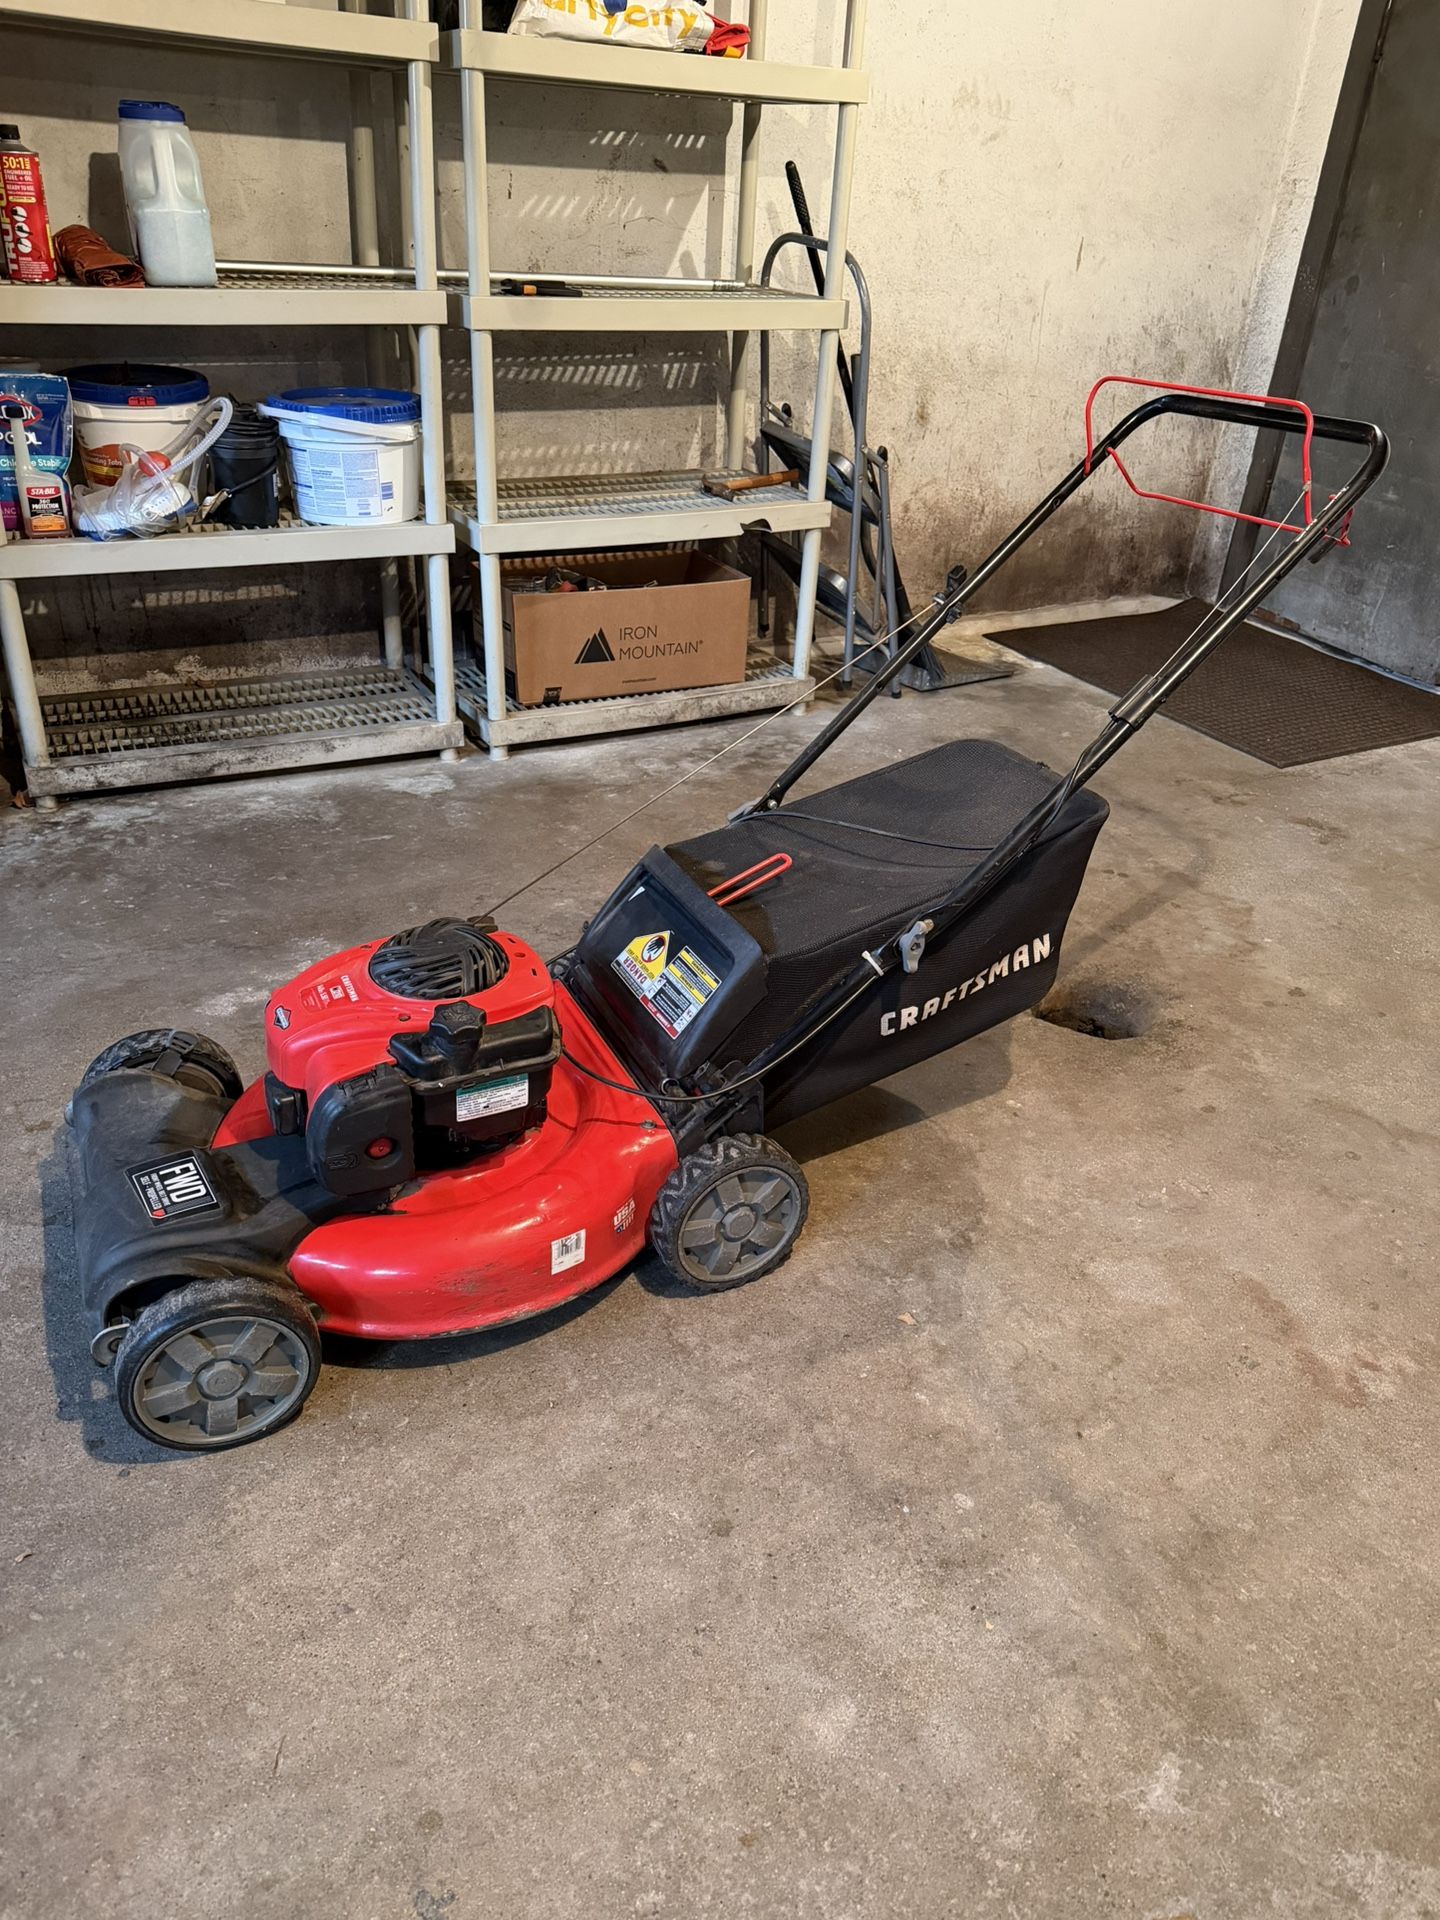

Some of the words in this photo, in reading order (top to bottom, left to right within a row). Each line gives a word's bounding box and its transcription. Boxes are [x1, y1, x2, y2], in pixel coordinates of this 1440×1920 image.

[2, 156, 25, 169] 50:1
[619, 625, 658, 641] IRON
[623, 956, 648, 985] DANGER
[340, 974, 360, 1002] CRAFTSMAN
[880, 933, 1051, 1037] CRAFTSMAN
[159, 1162, 207, 1203] FWD
[613, 1199, 635, 1226] USA
